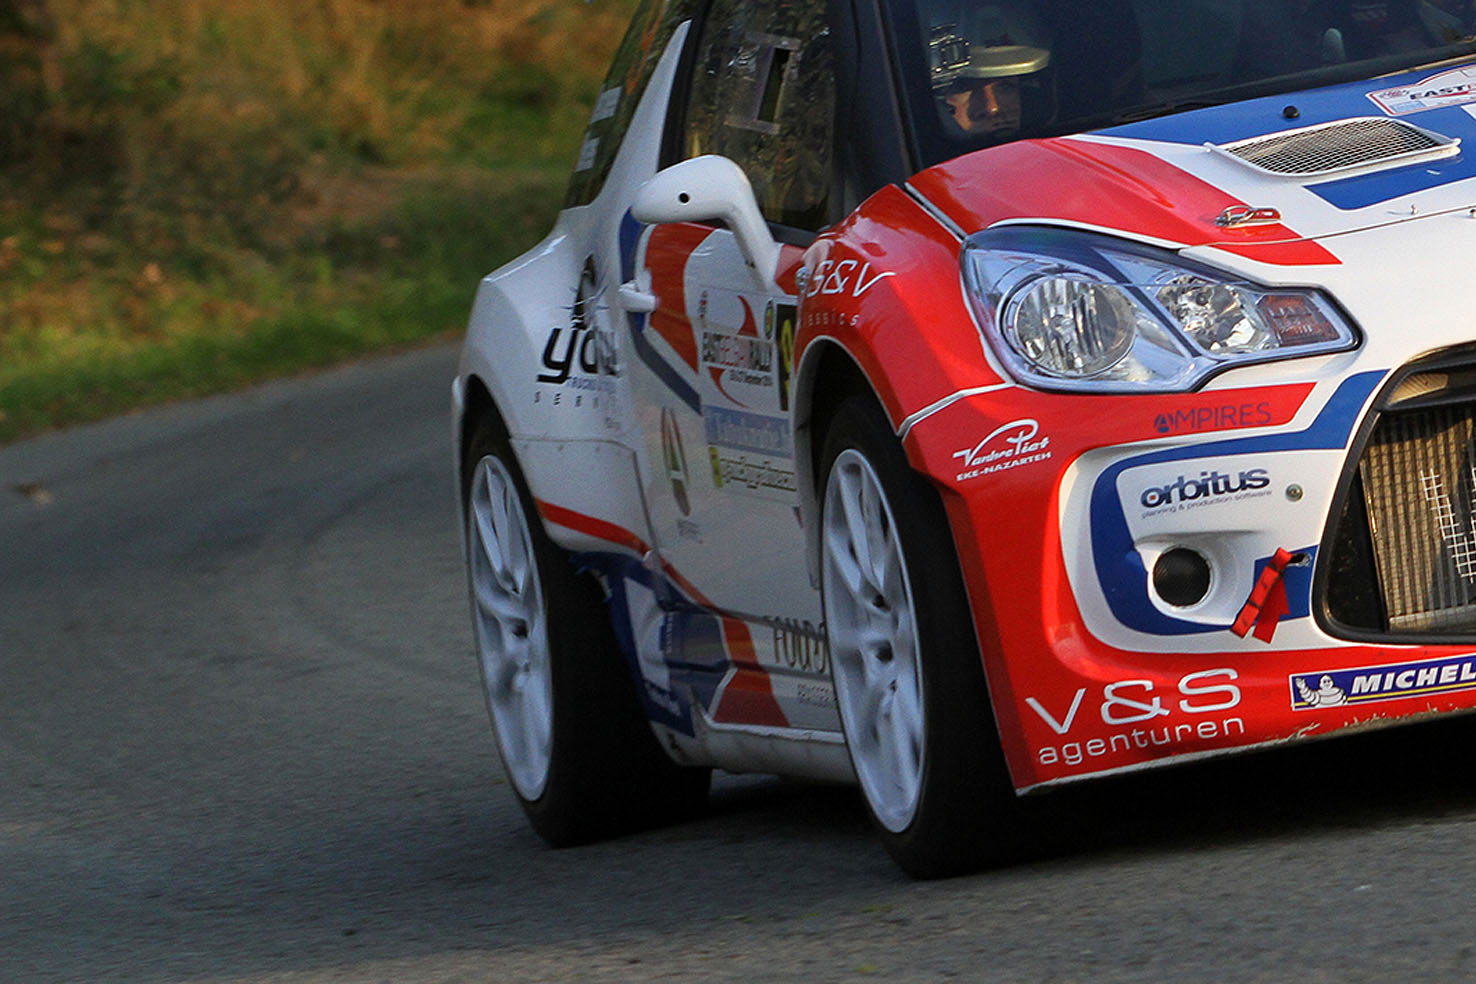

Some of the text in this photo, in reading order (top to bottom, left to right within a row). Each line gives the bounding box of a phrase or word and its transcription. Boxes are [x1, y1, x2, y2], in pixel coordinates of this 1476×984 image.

[1140, 468, 1271, 509] orbitus
[1187, 496, 1233, 510] production
[1024, 667, 1243, 736] V&S
[1037, 715, 1246, 766] agenturen
